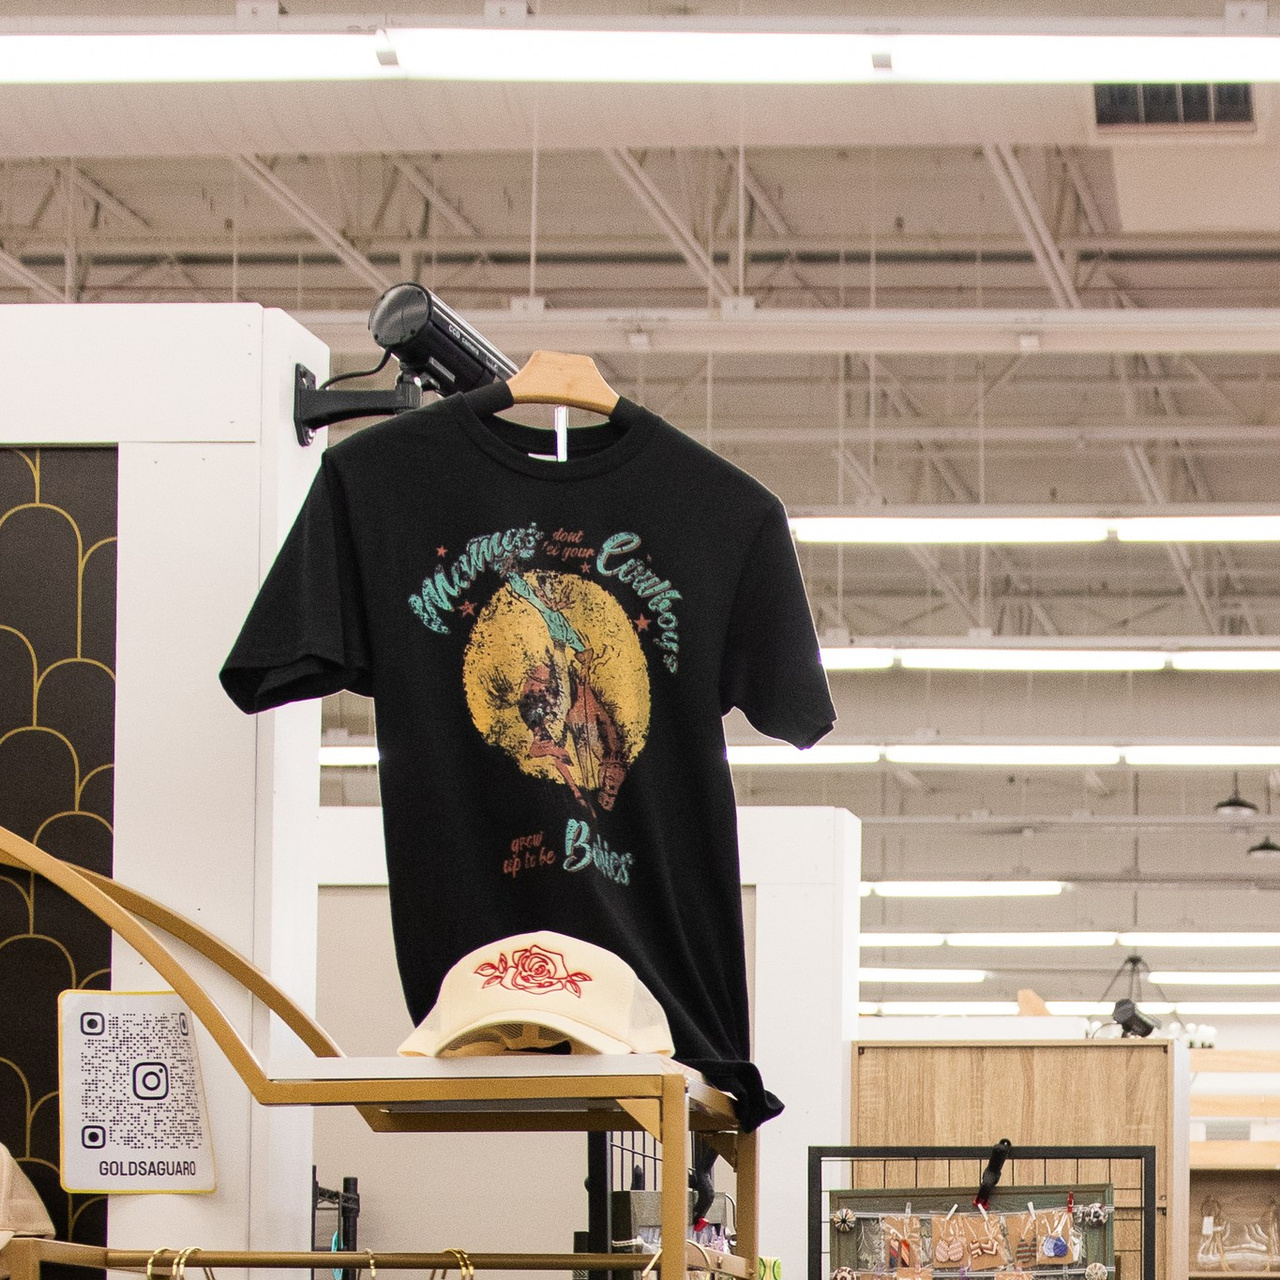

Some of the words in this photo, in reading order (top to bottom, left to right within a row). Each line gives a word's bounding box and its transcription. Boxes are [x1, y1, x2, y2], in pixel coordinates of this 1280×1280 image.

[561, 547, 595, 562] your
[596, 531, 683, 674] Cowboys
[503, 855, 521, 878] up
[540, 846, 556, 866] be
[99, 1160, 196, 1176] GOLDSAGUARO
